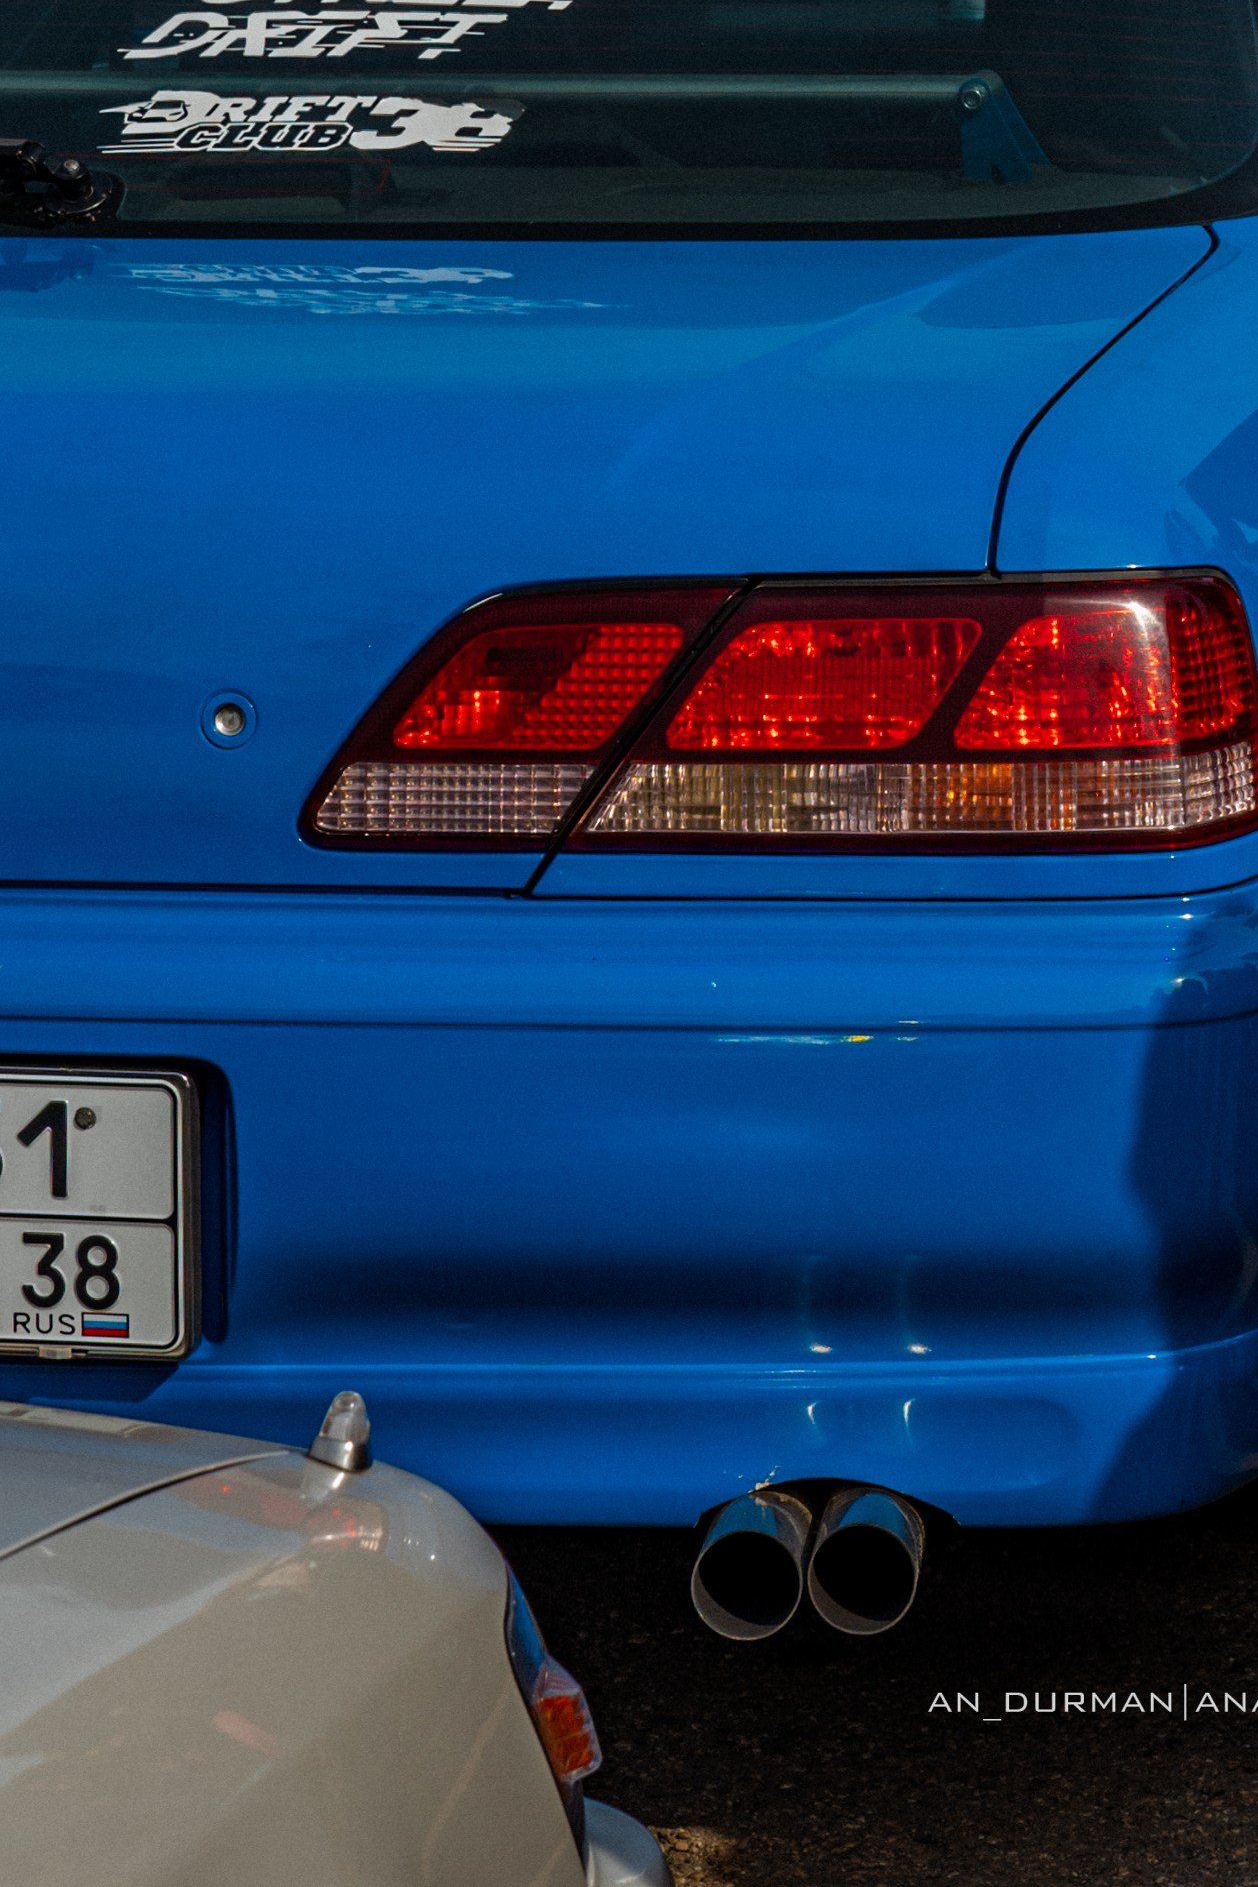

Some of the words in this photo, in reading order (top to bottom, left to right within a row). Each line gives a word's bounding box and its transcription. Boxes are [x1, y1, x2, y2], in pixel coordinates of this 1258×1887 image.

[172, 121, 354, 153] CLUB
[0, 1099, 69, 1199] 1
[21, 1231, 121, 1311] 38
[13, 1312, 76, 1336] RUS
